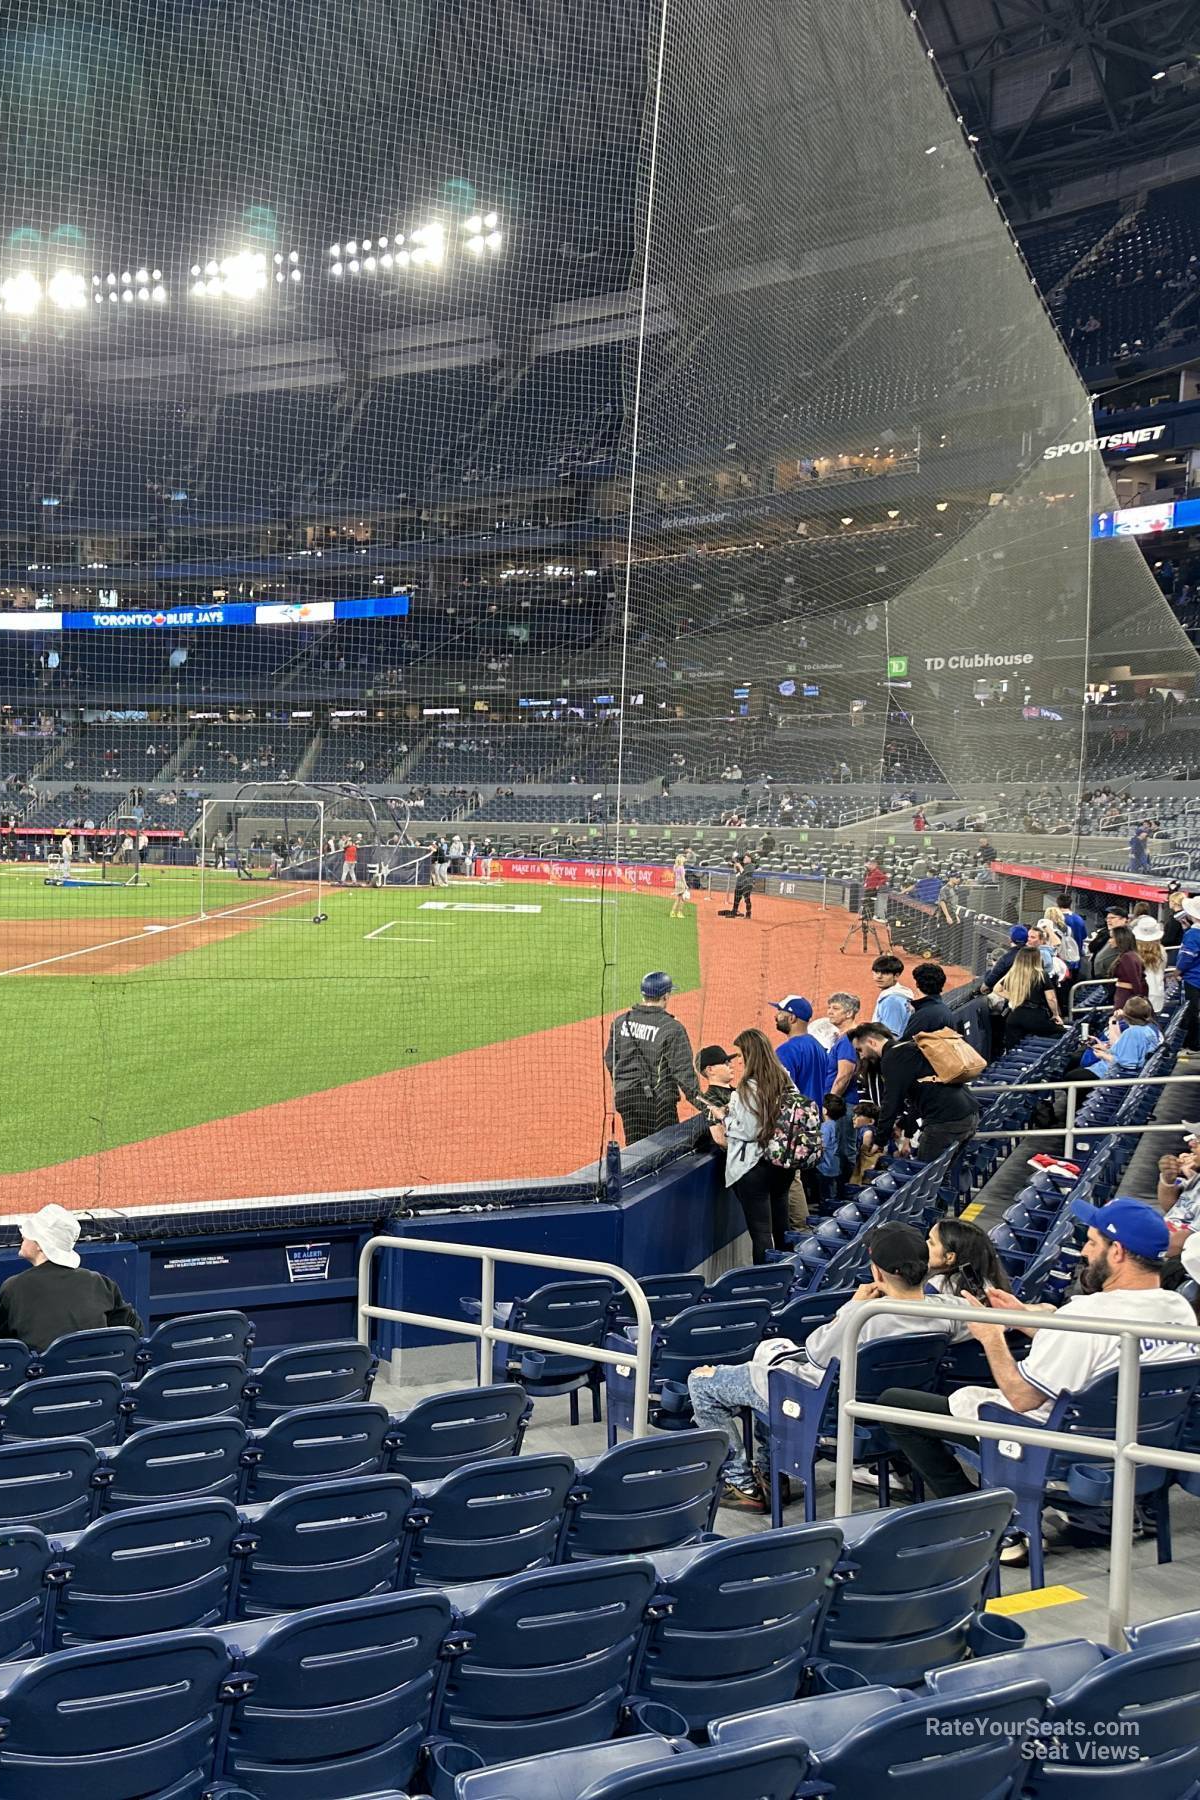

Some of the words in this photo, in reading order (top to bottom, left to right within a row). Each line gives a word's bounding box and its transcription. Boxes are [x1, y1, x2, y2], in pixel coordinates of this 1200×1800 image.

[1043, 424, 1166, 460] SPORTSNET
[661, 511, 728, 529] ticketmaster
[93, 614, 153, 626] TORONTO
[166, 613, 194, 624] BLUE
[195, 612, 224, 623] JAYS
[925, 657, 945, 671] TD
[948, 653, 1034, 670] Clubhouse
[511, 863, 529, 874] MAKE
[638, 870, 653, 884] DAY
[1006, 1443, 1013, 1454] 4
